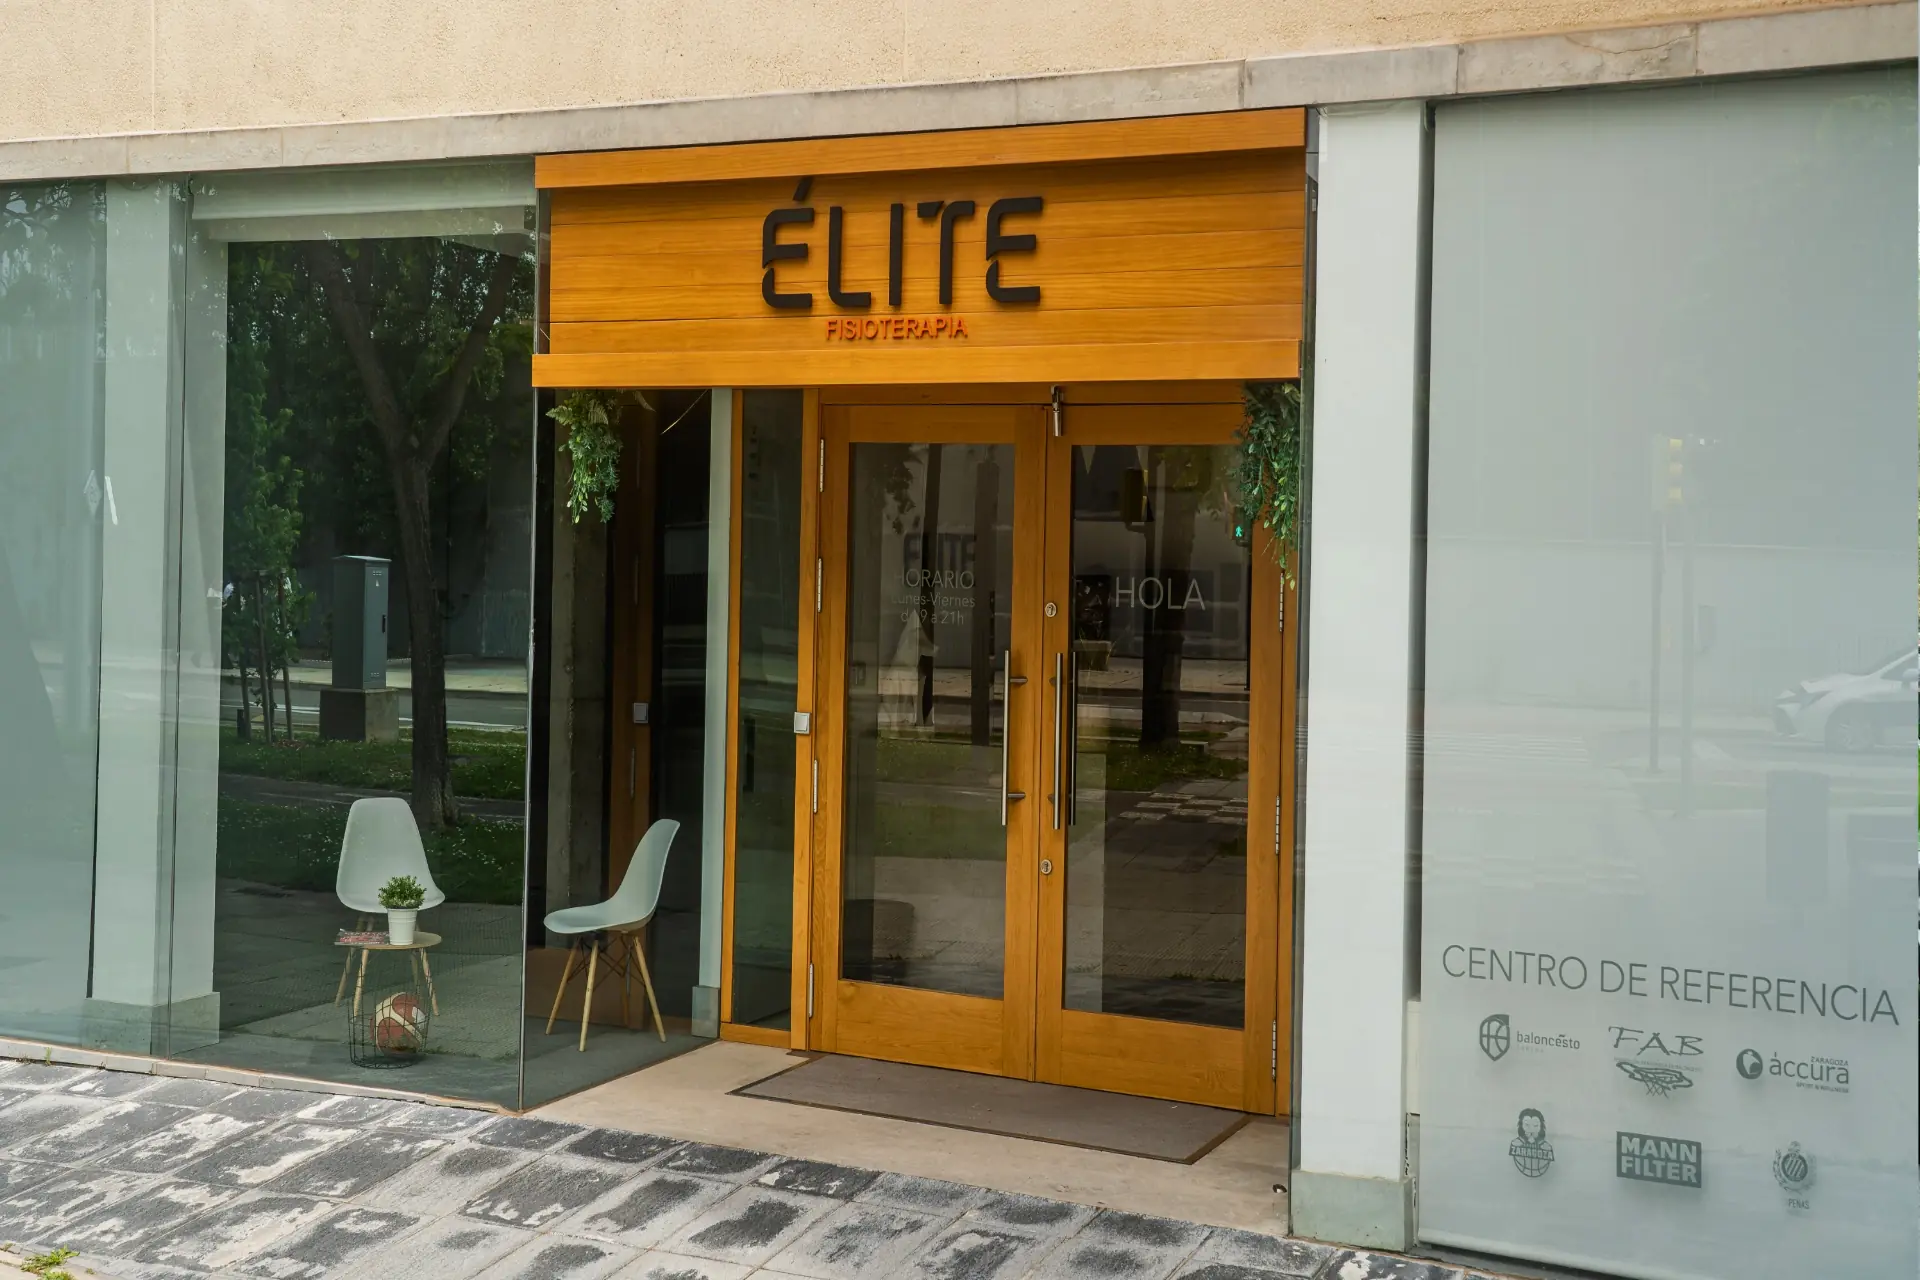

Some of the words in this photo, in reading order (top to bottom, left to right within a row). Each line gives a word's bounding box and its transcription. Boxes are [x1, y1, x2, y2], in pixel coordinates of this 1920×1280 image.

[761, 176, 1042, 309] ÉLITE
[826, 317, 968, 340] FISIOTERAPIA
[893, 567, 975, 589] HORARIO
[891, 592, 976, 607] Lunes-Viernes
[1115, 576, 1206, 611] HOLA
[940, 608, 965, 626] 21h
[1442, 944, 1588, 990] CENTRO
[1600, 959, 1648, 997] DE
[1660, 966, 1900, 1026] REFERENCIA
[1607, 1025, 1705, 1056] FAB
[1510, 1146, 1553, 1160] ZARAGOZA
[1620, 1135, 1698, 1163] MANN
[1620, 1157, 1698, 1183] FILTER
